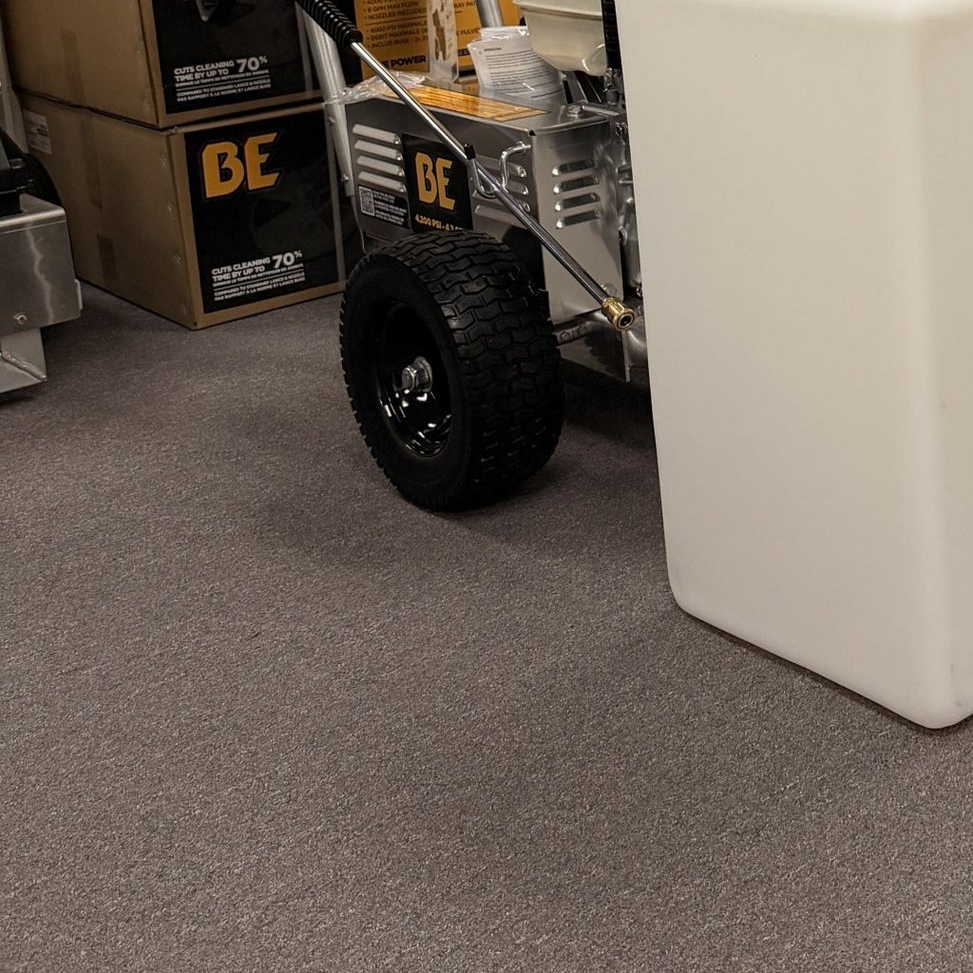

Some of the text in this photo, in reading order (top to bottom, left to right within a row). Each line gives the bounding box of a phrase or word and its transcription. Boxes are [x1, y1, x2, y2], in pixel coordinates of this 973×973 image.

[202, 134, 276, 197] BE
[415, 152, 455, 210] BE
[211, 265, 232, 275] CUTS
[233, 256, 271, 271] CLEANING
[272, 249, 304, 269] 70%
[212, 264, 266, 282] TIME BY UP TO
